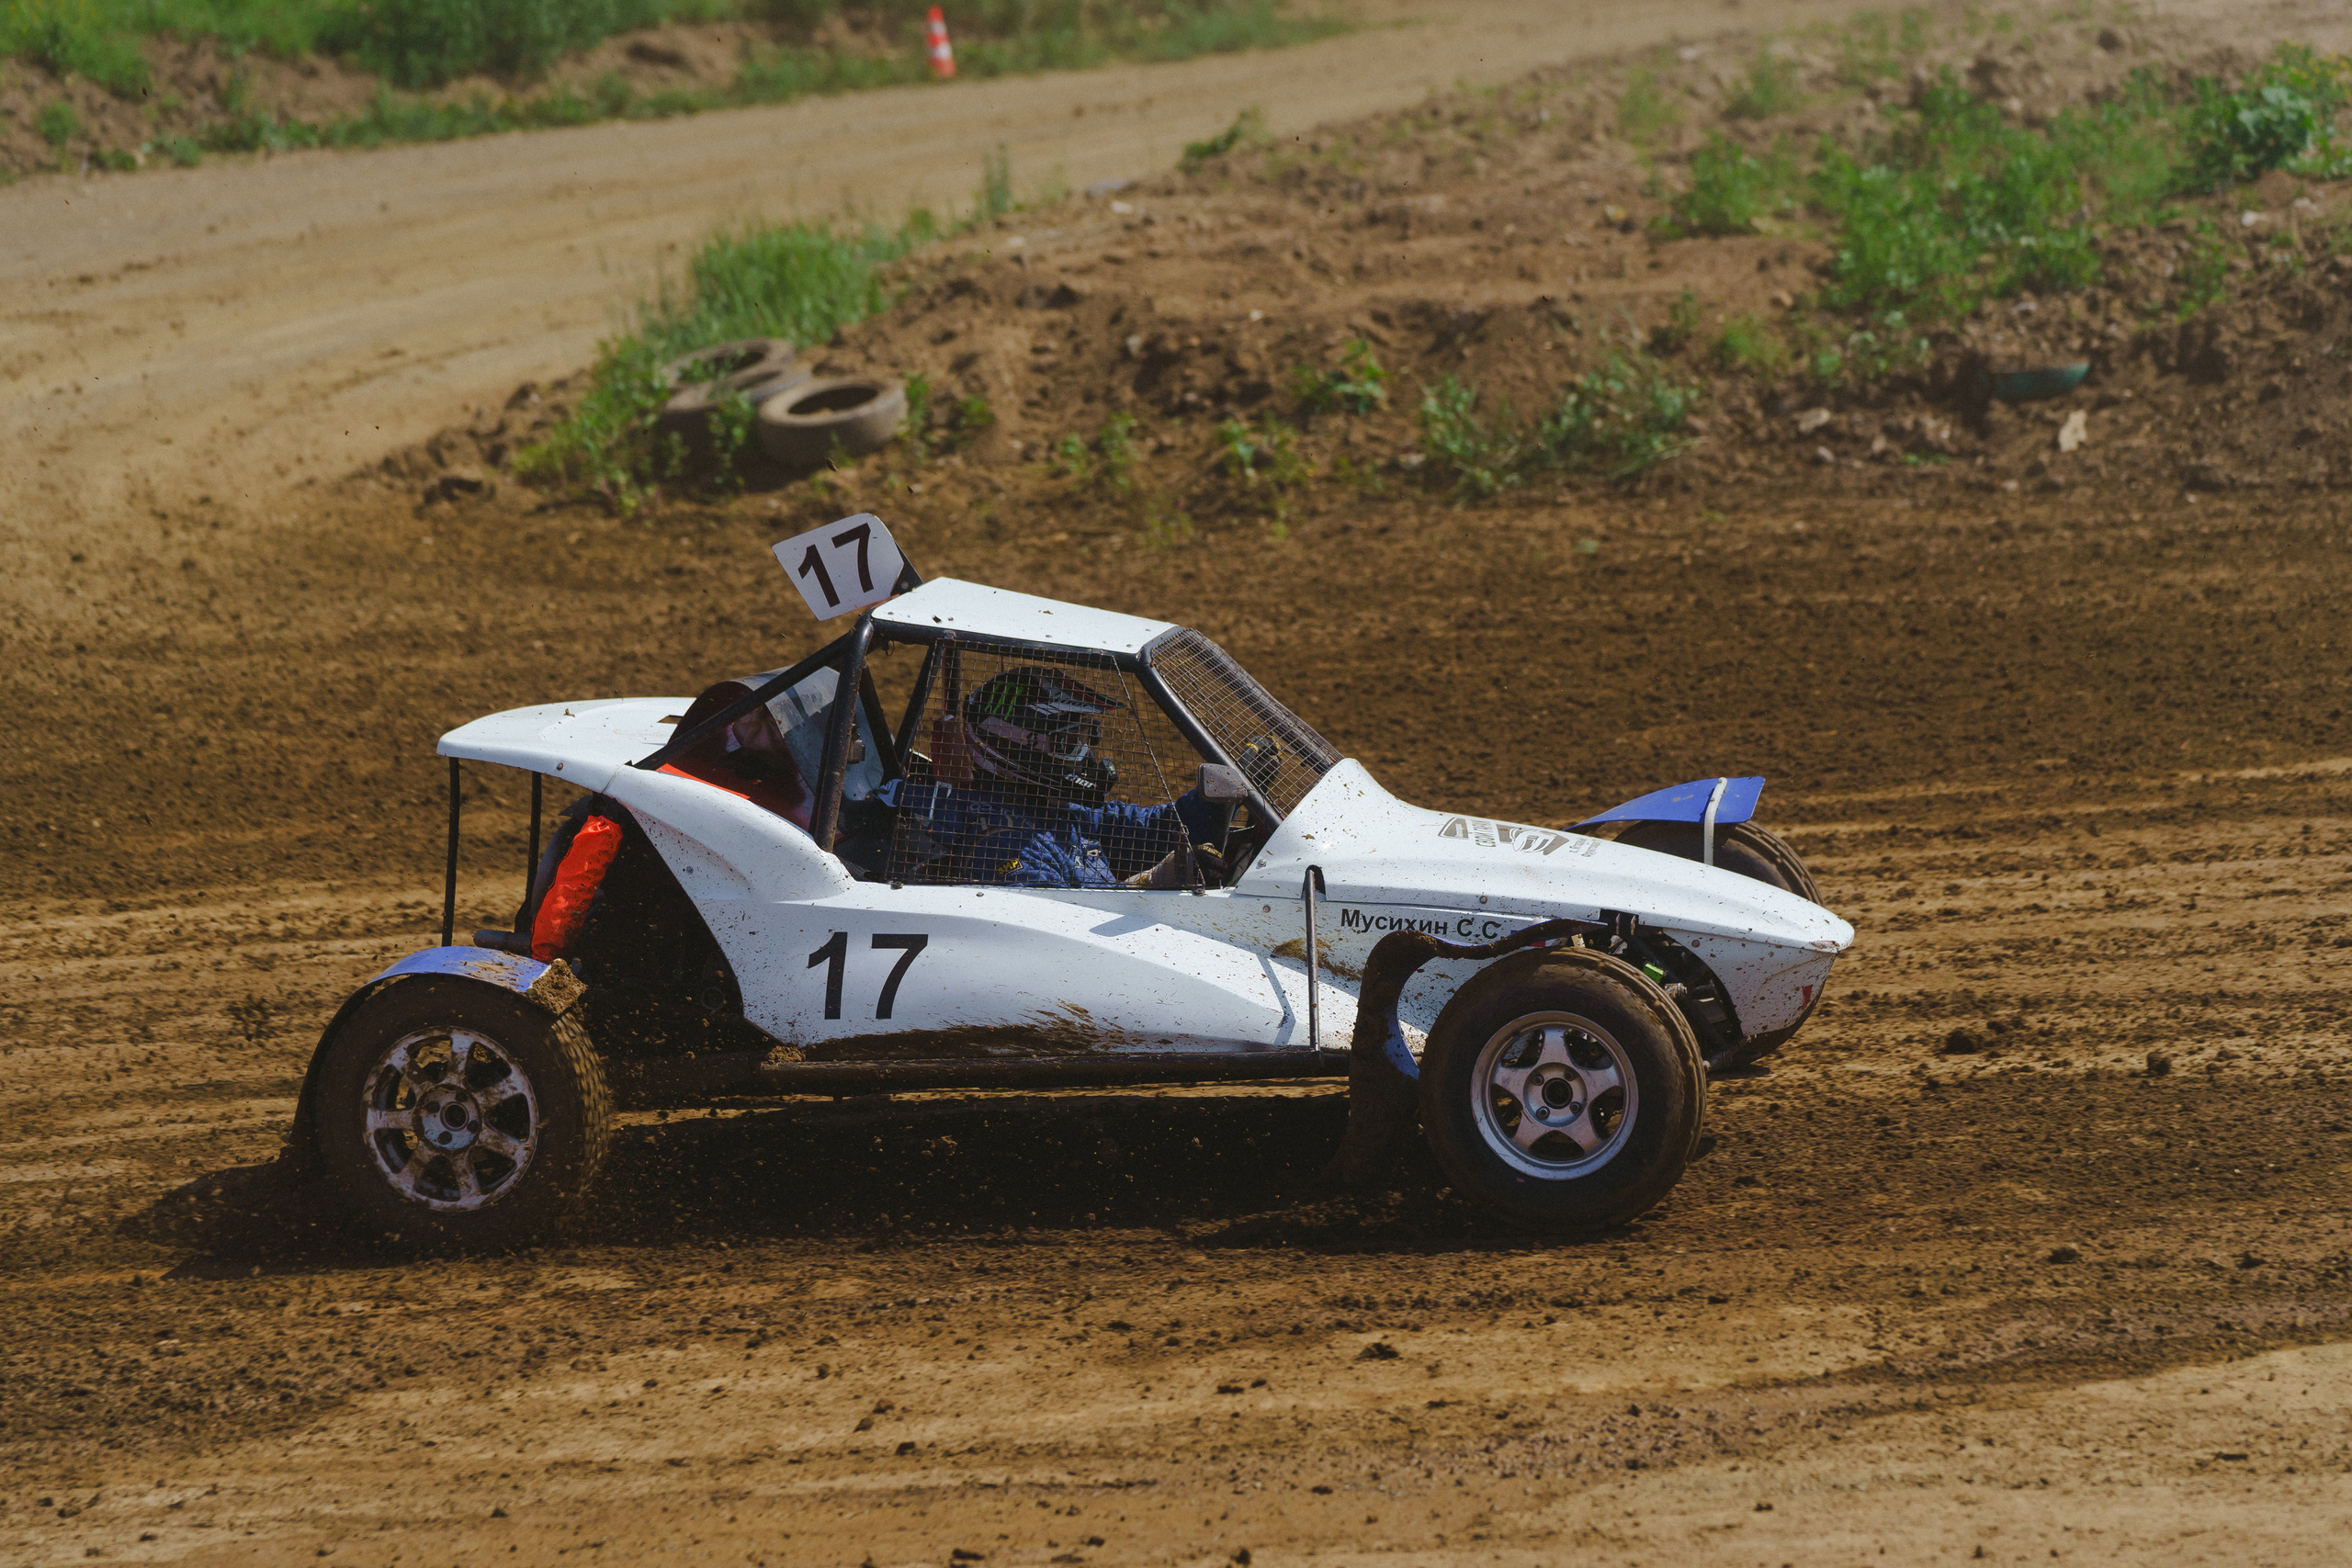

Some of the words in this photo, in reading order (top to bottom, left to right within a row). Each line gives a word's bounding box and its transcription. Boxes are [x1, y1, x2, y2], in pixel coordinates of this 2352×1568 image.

[797, 522, 874, 608] 17
[1340, 908, 1448, 935] Мусихин
[808, 931, 929, 1020] 17
